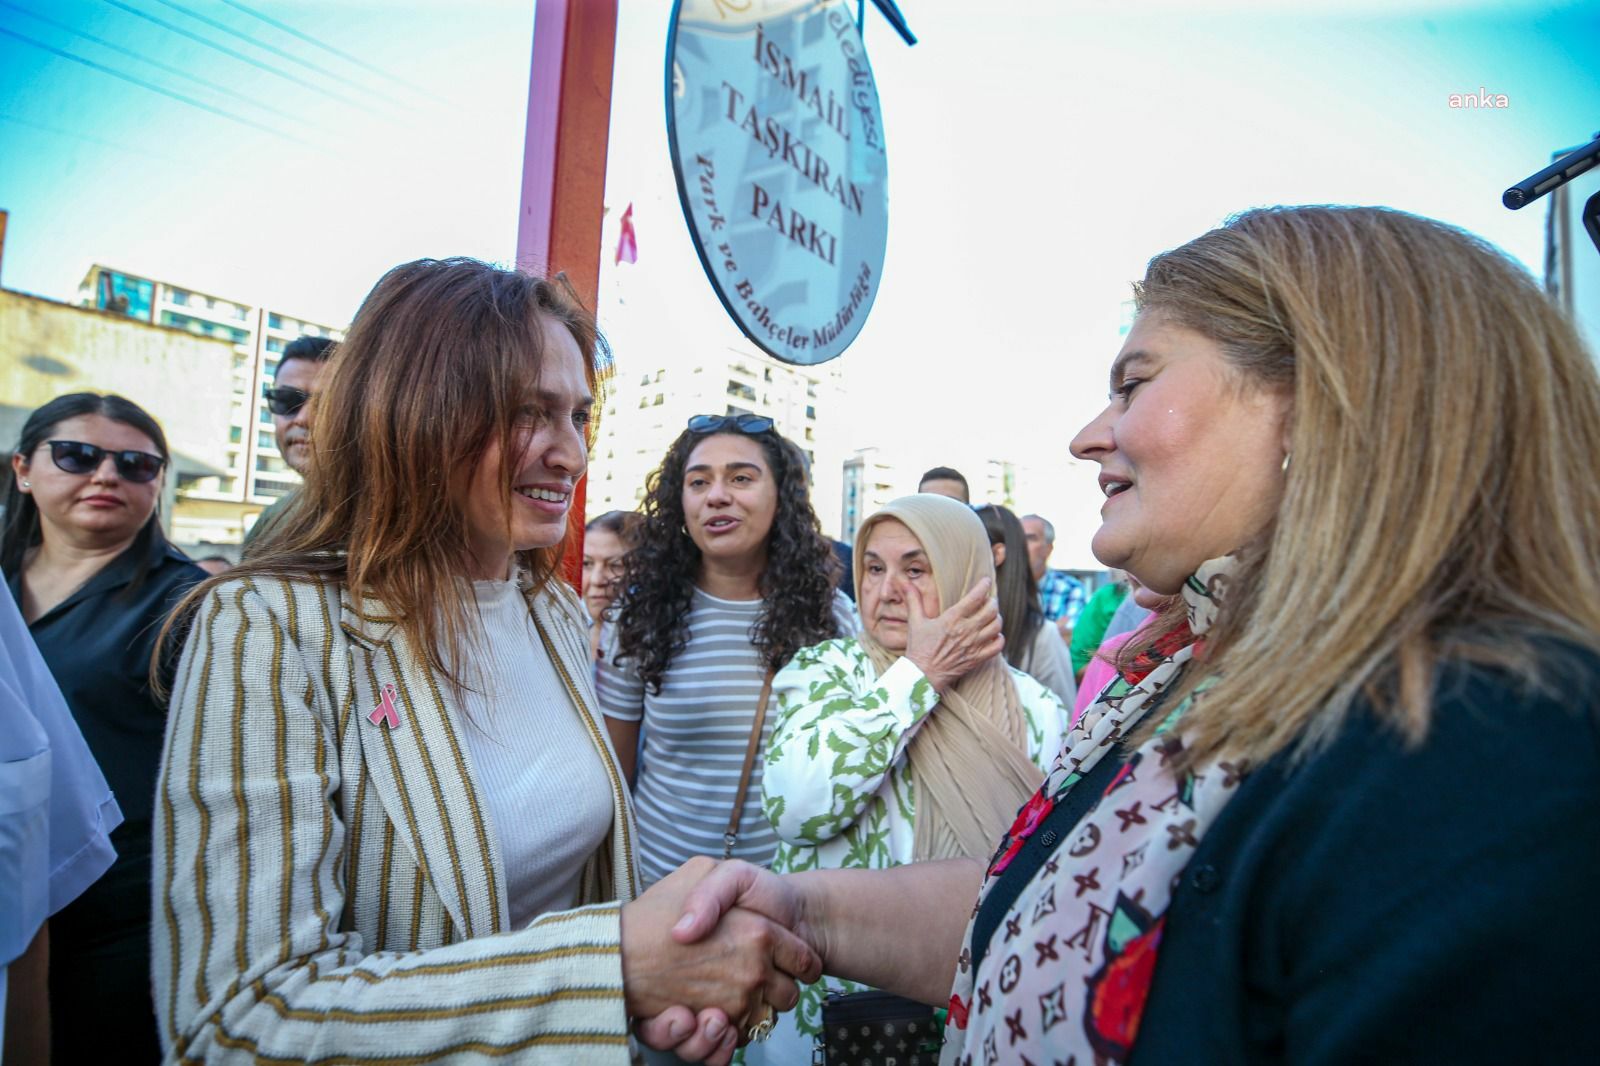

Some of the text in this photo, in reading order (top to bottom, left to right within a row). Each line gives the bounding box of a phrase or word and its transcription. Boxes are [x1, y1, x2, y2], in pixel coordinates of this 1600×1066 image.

[721, 80, 865, 218] TAŞKIRAN
[753, 22, 851, 142] İSMAİL
[826, 9, 886, 155] elediyesi
[695, 152, 872, 350] Park ve Bahçeler Müdürlüğü
[750, 180, 837, 267] PARKI
